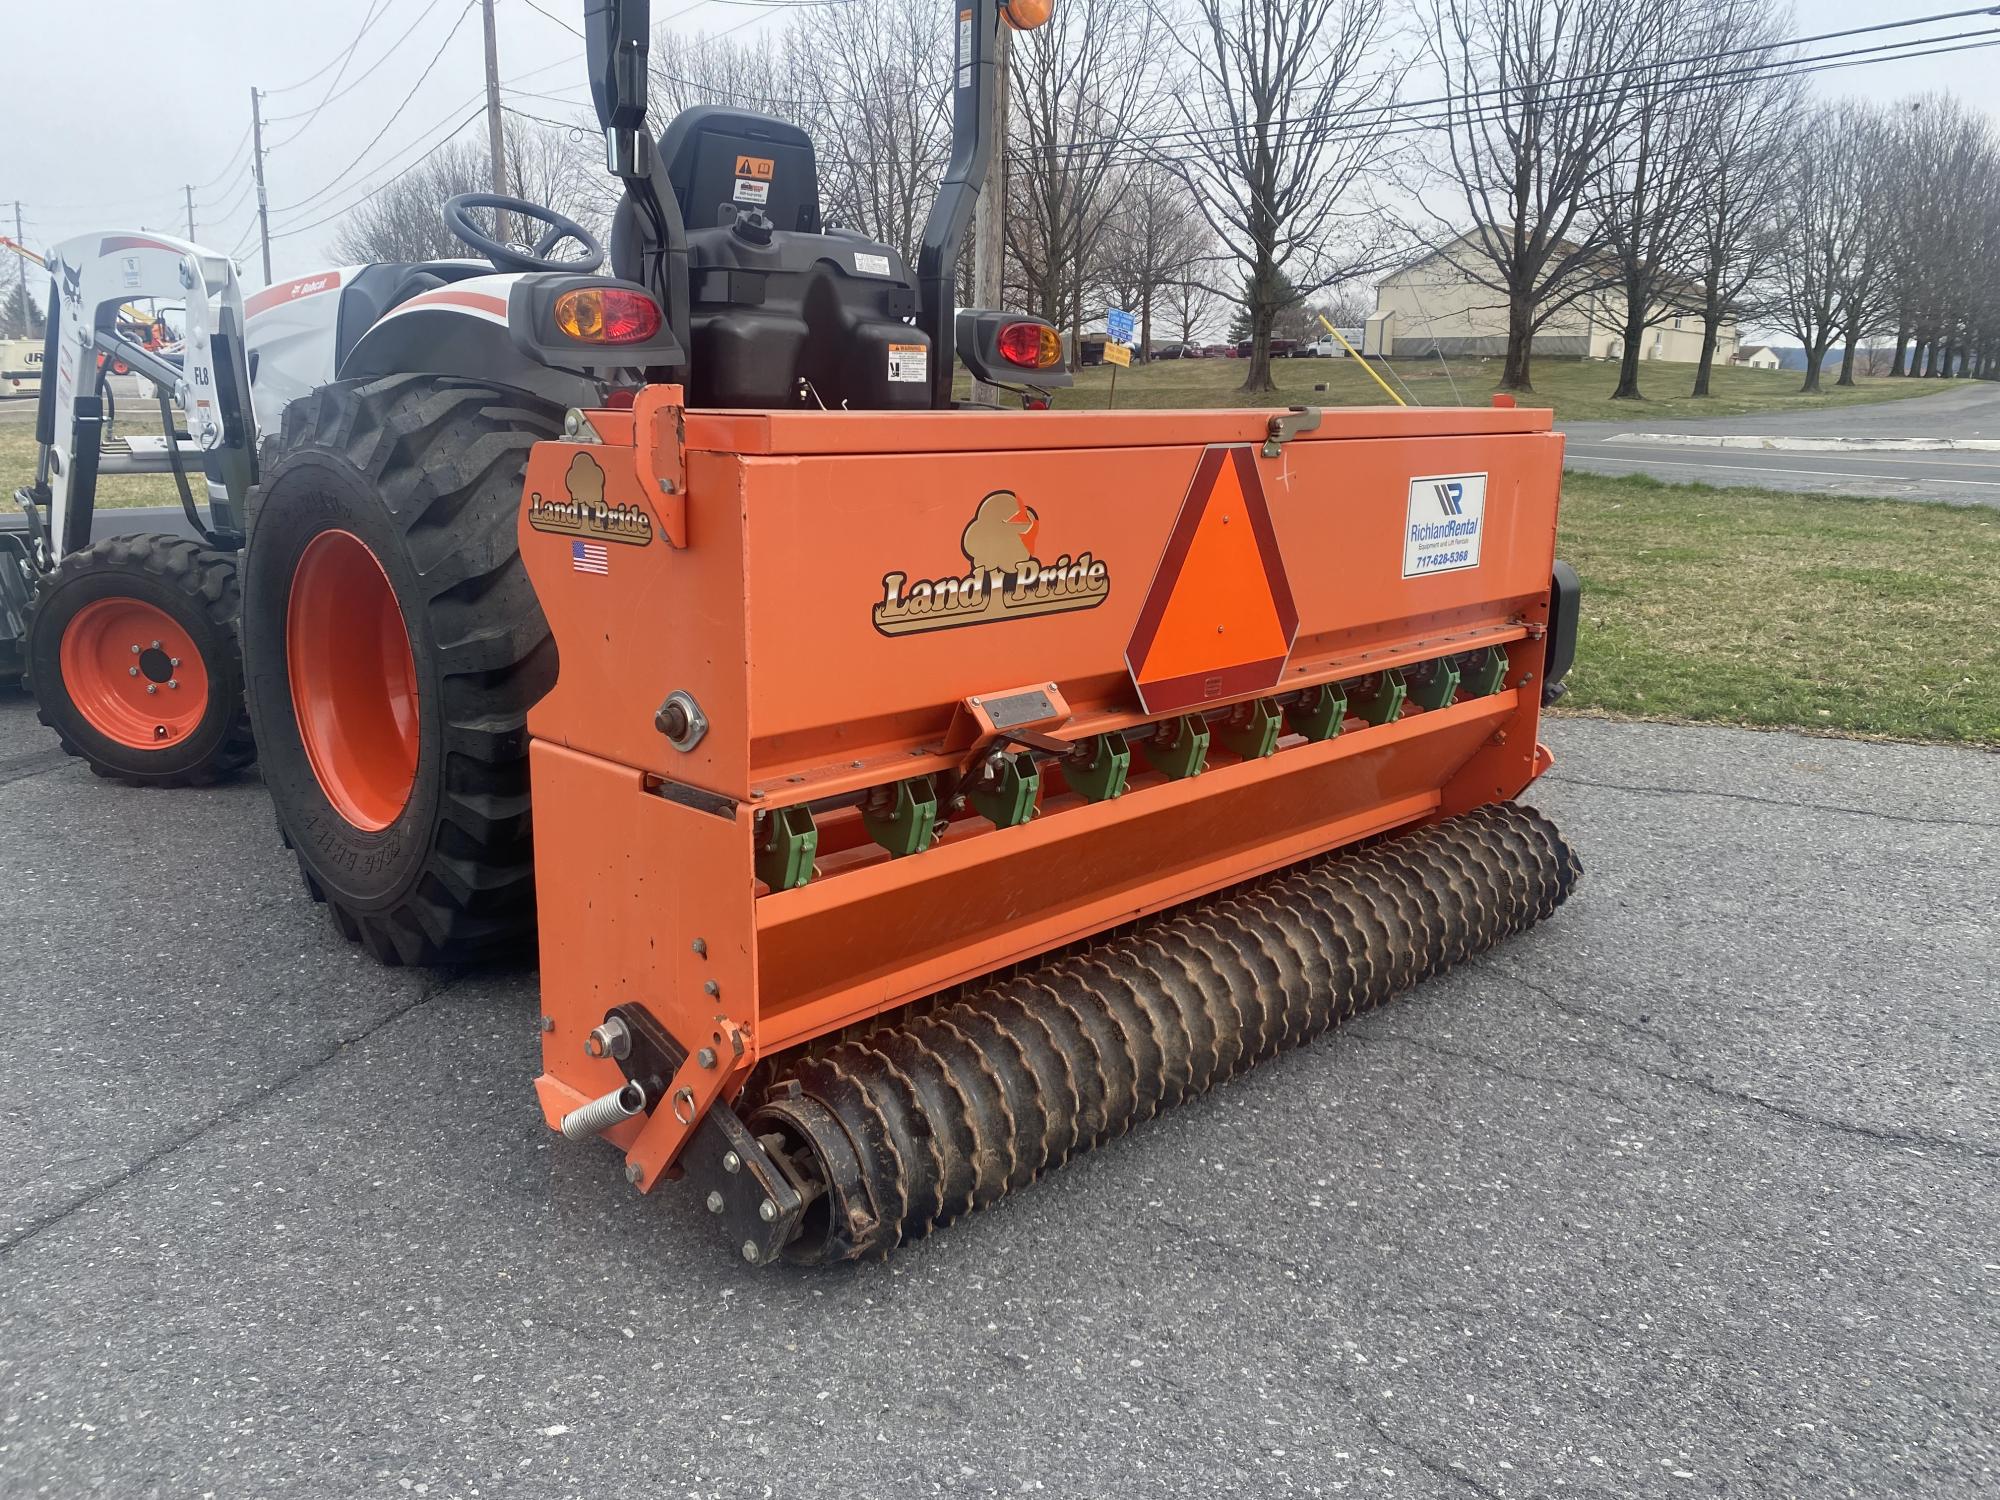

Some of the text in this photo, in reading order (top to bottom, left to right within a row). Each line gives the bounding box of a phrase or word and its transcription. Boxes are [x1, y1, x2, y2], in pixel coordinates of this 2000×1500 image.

[194, 366, 209, 386] FL8
[532, 493, 650, 535] Land Pride
[1416, 550, 1469, 568] 717-628-5368
[881, 551, 1108, 618] Land Pride
